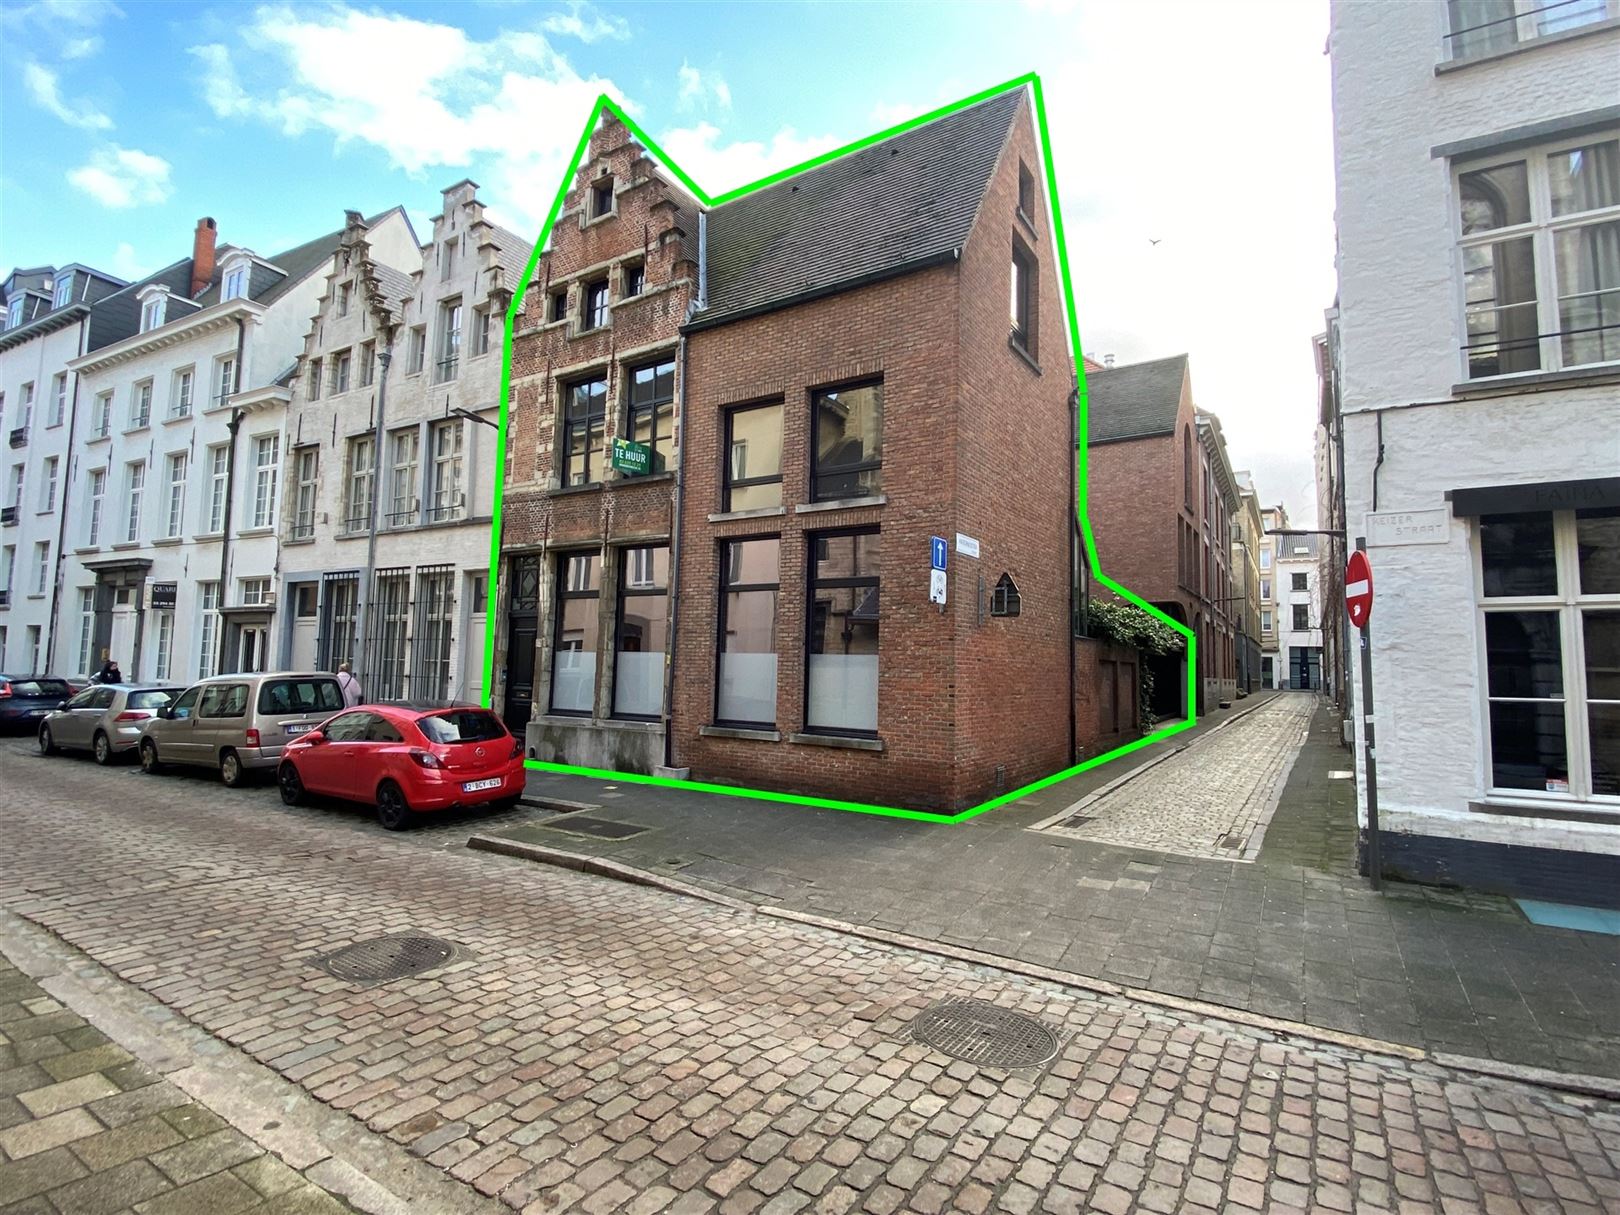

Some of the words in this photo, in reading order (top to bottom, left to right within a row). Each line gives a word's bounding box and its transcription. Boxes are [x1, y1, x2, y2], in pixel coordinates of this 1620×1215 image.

[615, 448, 624, 458] TE
[625, 450, 646, 463] HUUR
[1372, 515, 1414, 525] KEIZER
[1396, 524, 1442, 535] STRAAT
